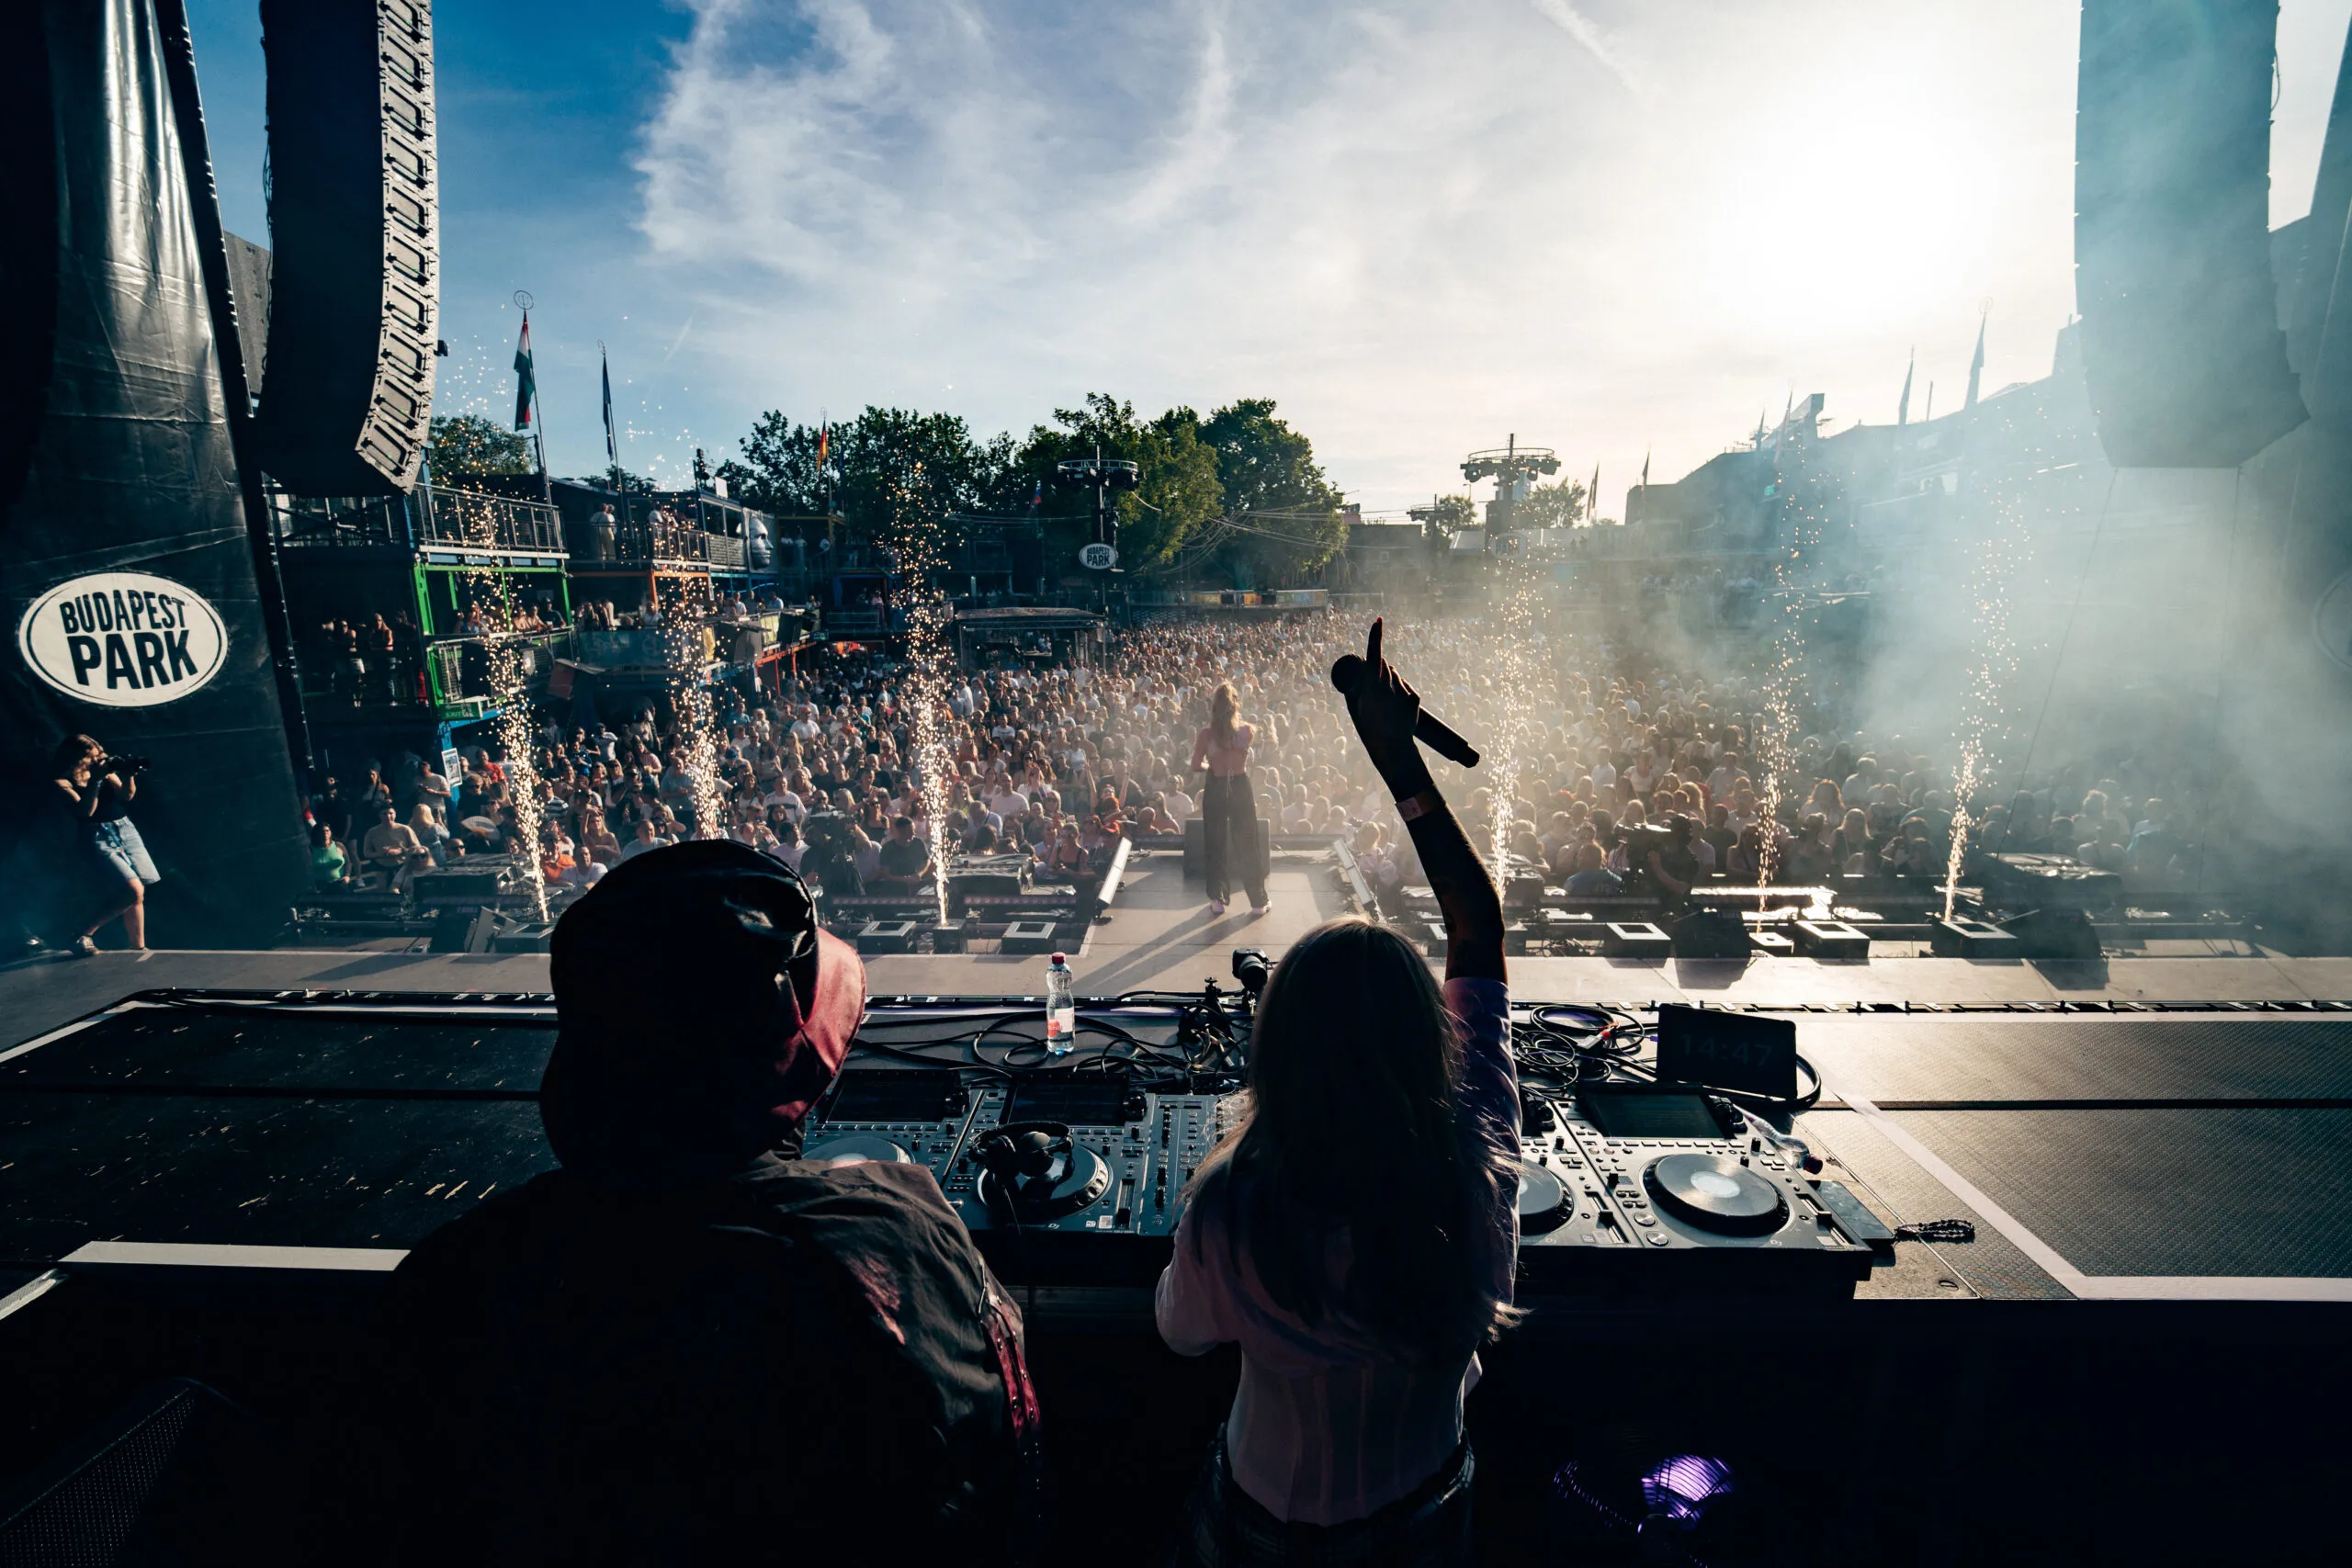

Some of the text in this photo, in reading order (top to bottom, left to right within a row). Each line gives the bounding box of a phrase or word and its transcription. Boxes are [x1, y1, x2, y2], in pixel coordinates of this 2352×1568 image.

[1086, 547, 1110, 555] BUDAPEST
[1086, 554, 1110, 566] PARK
[59, 589, 187, 635] BUDAPEST
[67, 628, 198, 690] PARK
[1679, 1032, 1773, 1067] 14:47
